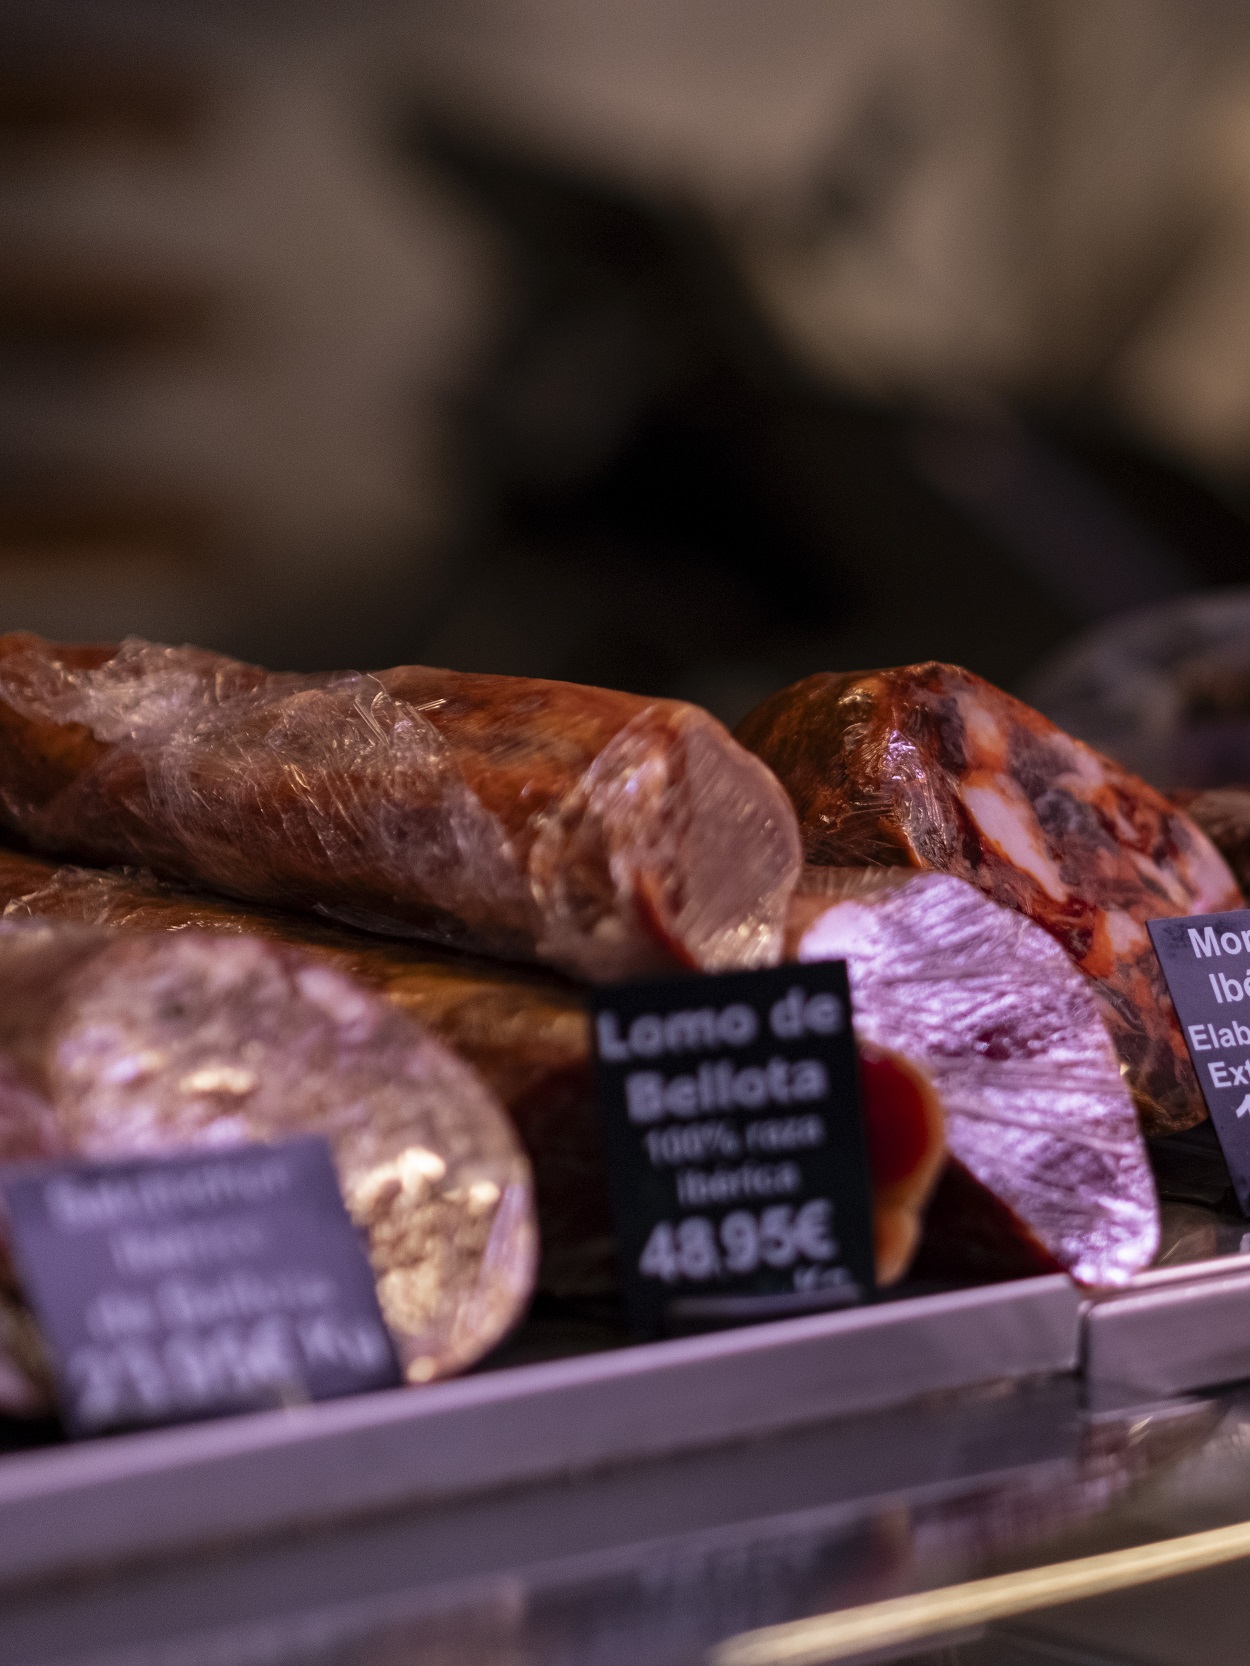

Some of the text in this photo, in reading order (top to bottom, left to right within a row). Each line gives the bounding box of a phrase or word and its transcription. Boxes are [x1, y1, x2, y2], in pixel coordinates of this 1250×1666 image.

[597, 985, 844, 1062] Lomo de
[625, 1056, 829, 1124] Bellota
